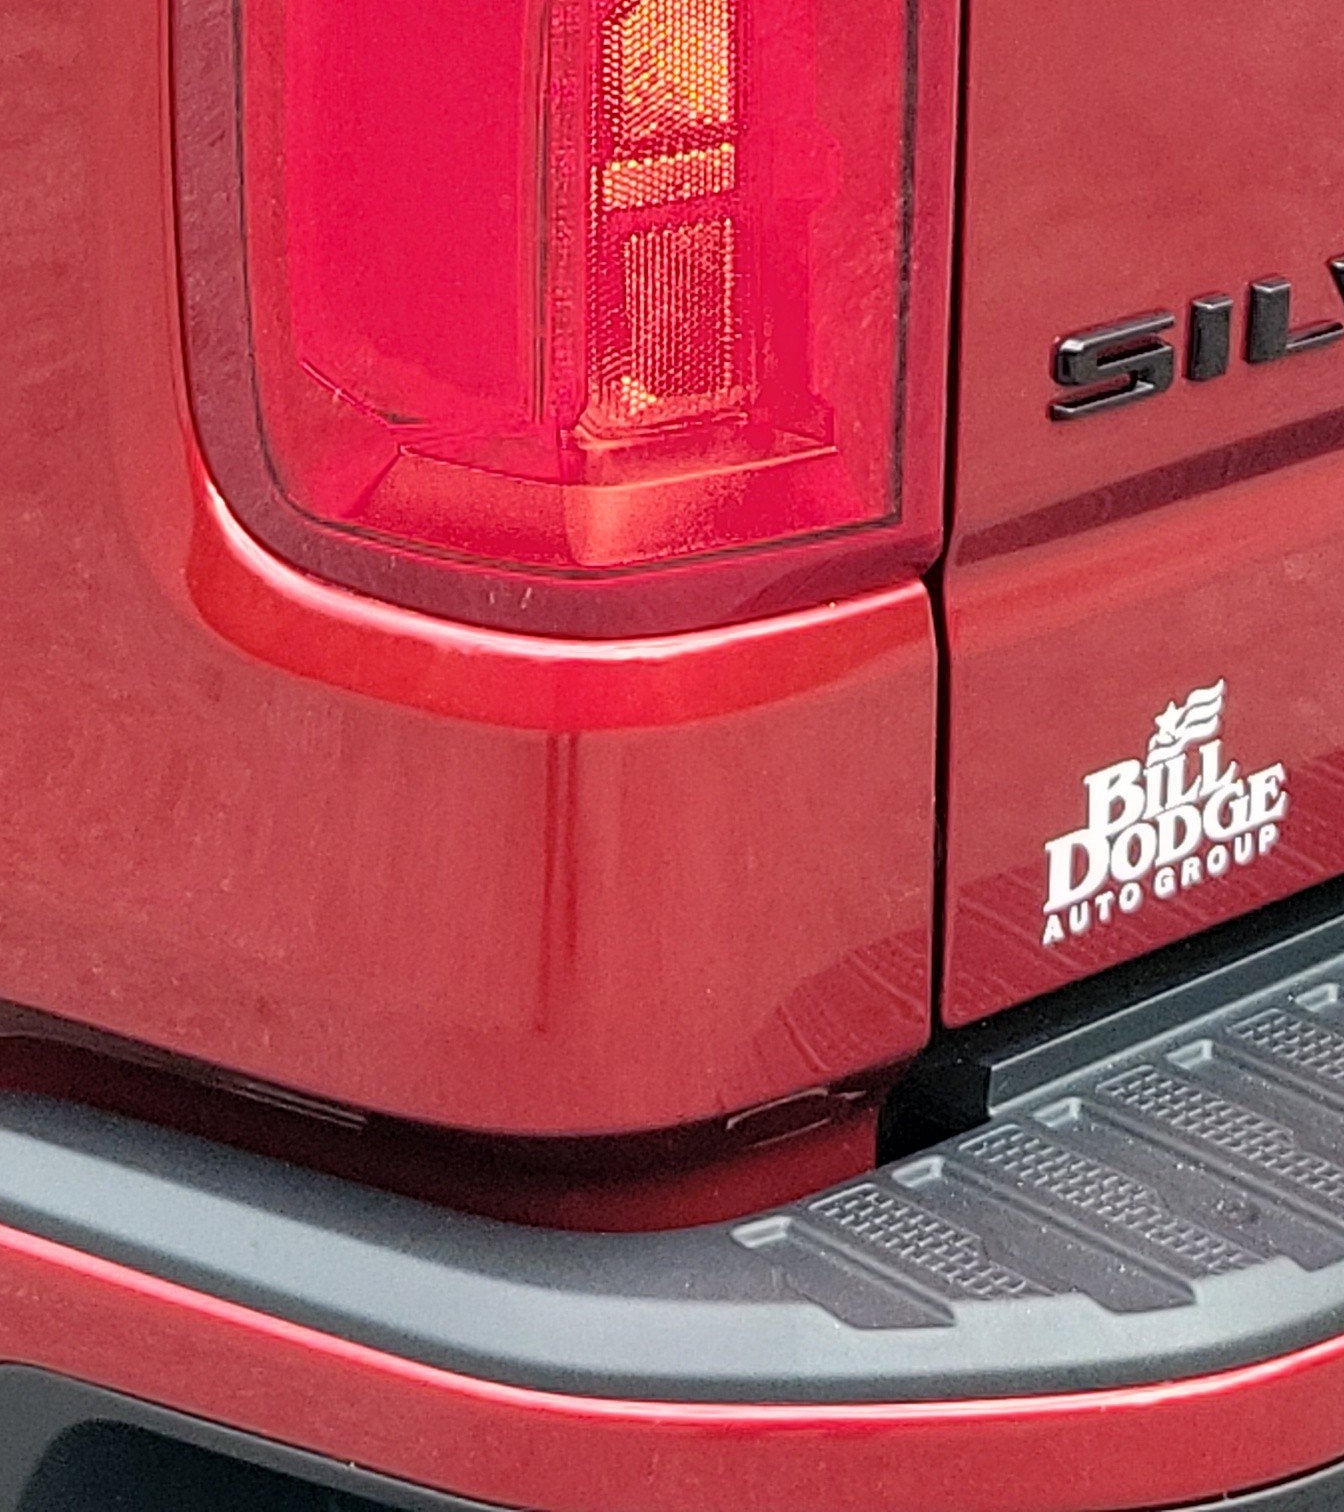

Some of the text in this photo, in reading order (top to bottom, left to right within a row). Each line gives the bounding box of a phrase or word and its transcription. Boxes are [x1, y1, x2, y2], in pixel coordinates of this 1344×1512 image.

[1043, 763, 1287, 914] DODGE
[1083, 739, 1238, 835] BILL
[1043, 824, 1279, 945] AUTO GROUP
